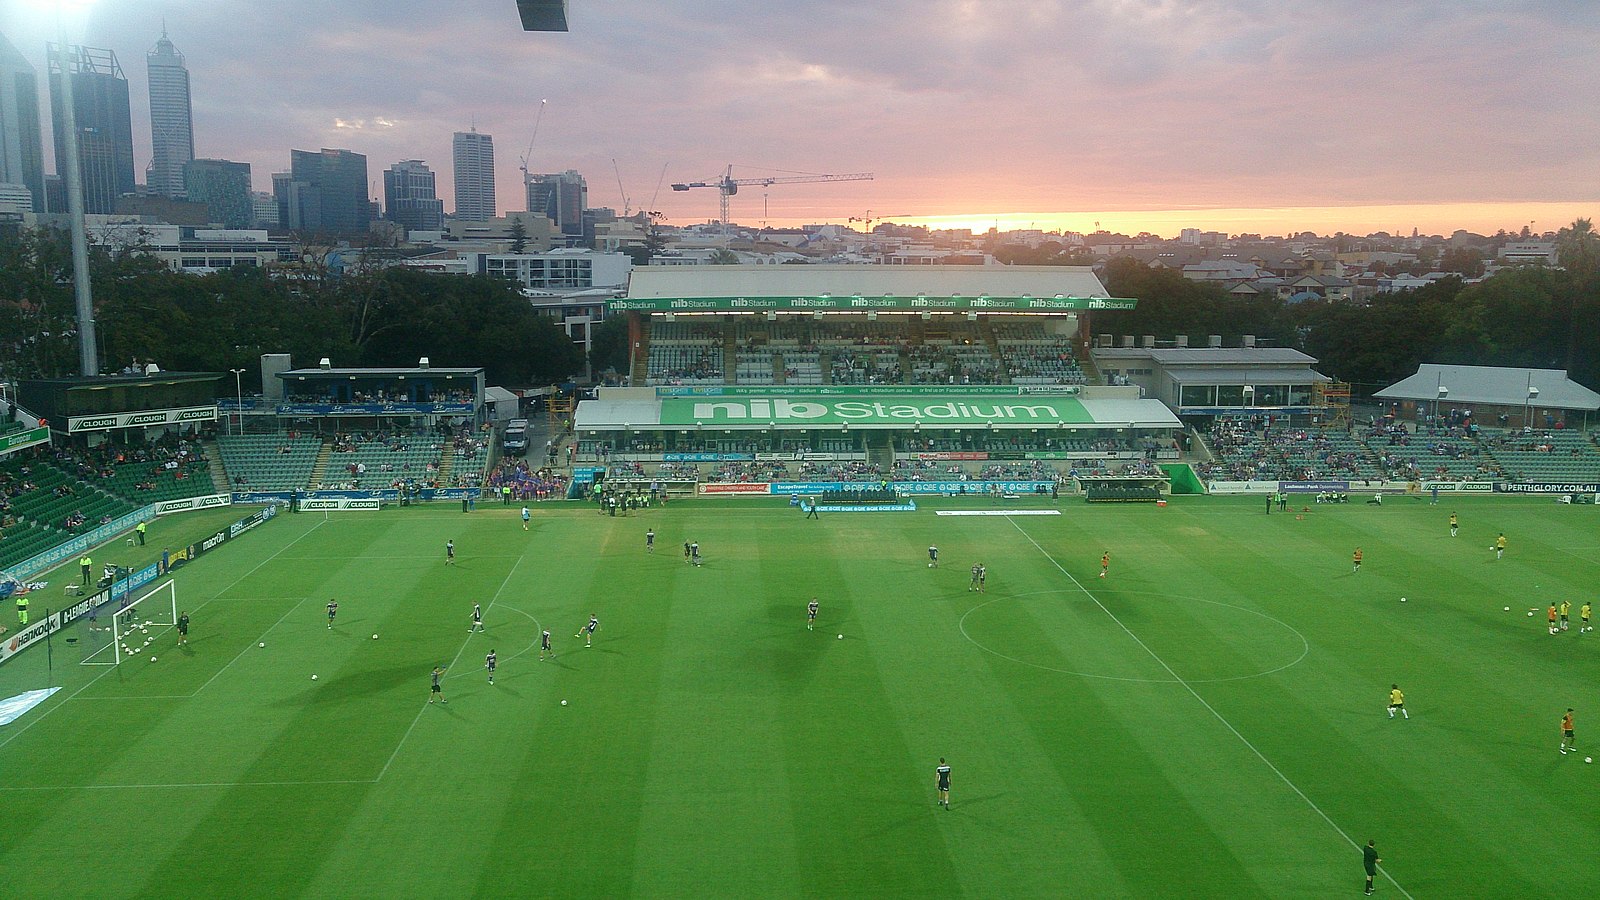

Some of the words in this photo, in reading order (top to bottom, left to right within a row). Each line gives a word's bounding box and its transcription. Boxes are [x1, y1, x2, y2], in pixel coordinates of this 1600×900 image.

[83, 419, 116, 428] CLOUGH
[134, 415, 165, 423] CLOUGH
[183, 411, 213, 419] CLOUGH
[8, 434, 31, 445] Europcar
[1507, 484, 1597, 492] PERTHGLORY.COM.AU
[166, 502, 192, 510] CLOUGH
[202, 532, 225, 551] macron
